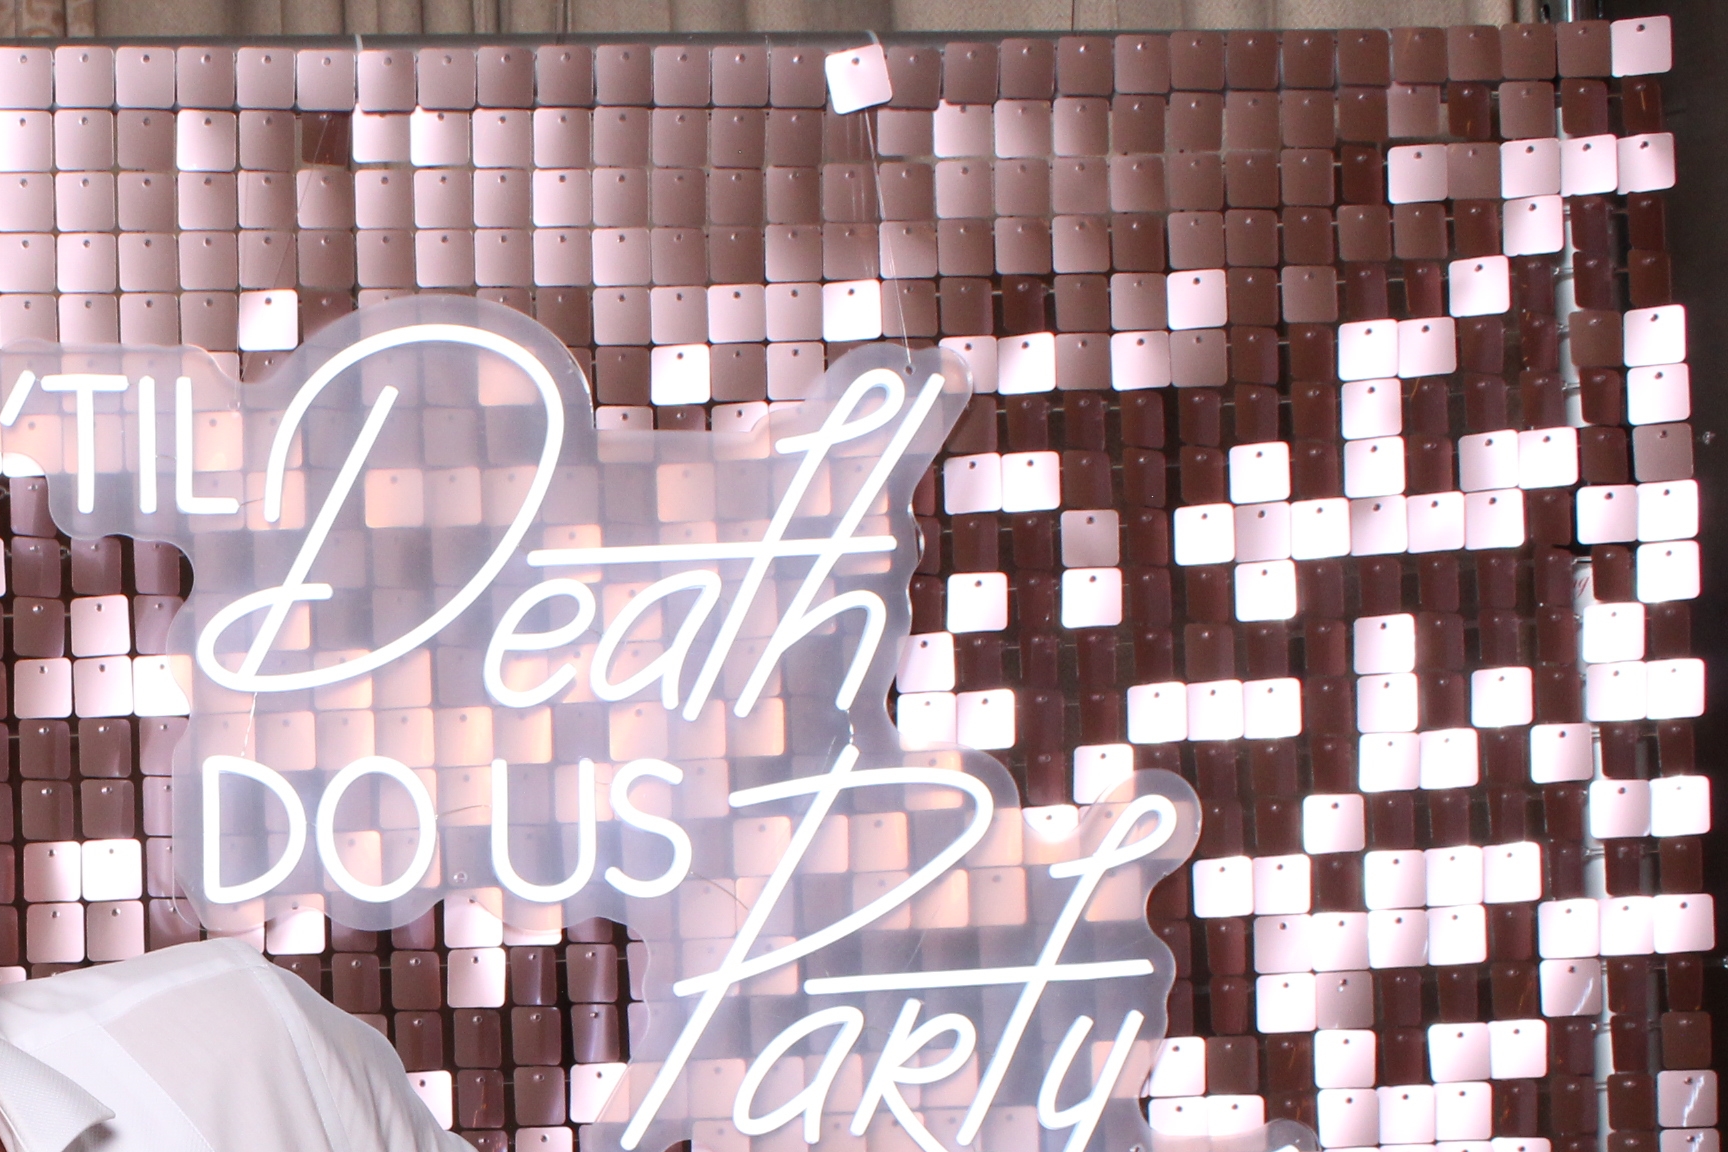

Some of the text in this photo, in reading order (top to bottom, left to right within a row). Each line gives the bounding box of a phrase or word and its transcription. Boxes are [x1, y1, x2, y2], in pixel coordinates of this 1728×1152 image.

[0, 324, 945, 720] 'TIL Death
[203, 755, 438, 904] DO
[491, 757, 693, 903] US
